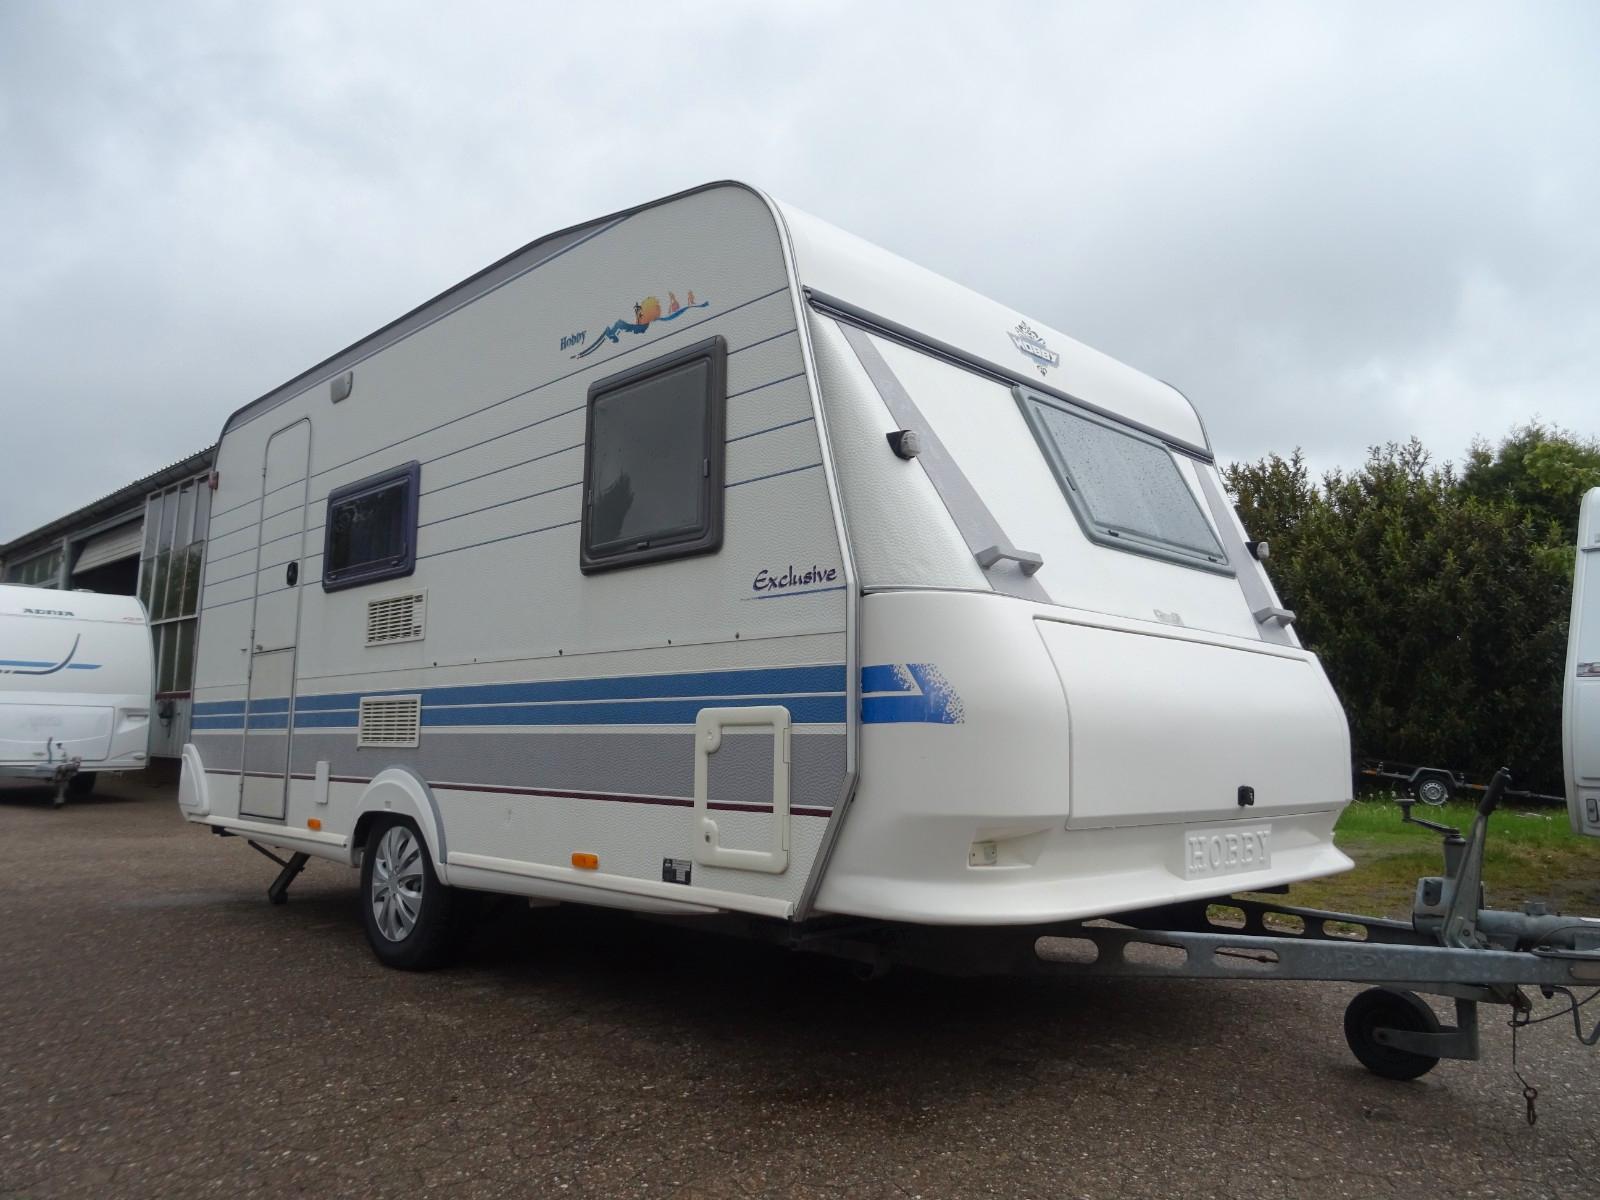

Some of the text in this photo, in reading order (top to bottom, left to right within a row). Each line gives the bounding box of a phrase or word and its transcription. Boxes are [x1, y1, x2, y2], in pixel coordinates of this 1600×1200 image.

[560, 330, 587, 351] Hobby
[1012, 335, 1057, 362] HOBBY
[752, 564, 837, 591] Exclusive
[1188, 830, 1270, 870] HOBBY
